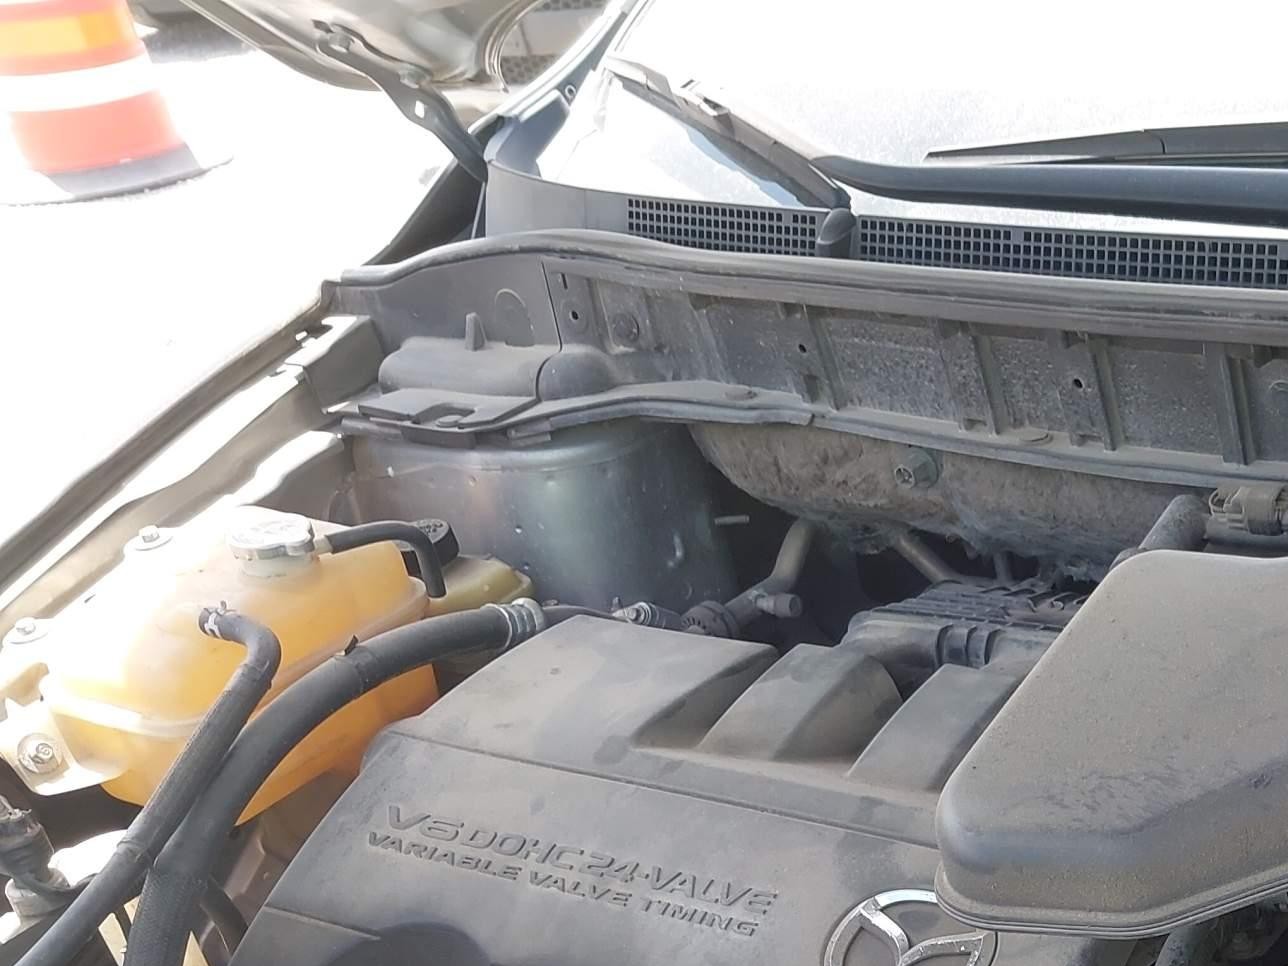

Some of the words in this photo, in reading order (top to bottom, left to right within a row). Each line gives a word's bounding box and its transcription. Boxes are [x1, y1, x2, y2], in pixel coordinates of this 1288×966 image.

[367, 830, 522, 881] VARIABLE
[528, 868, 633, 908] VALVE
[641, 896, 761, 938] TIMING
[386, 803, 465, 842] V6
[461, 829, 585, 871] DOHC
[584, 850, 779, 916] 24-VALVE
